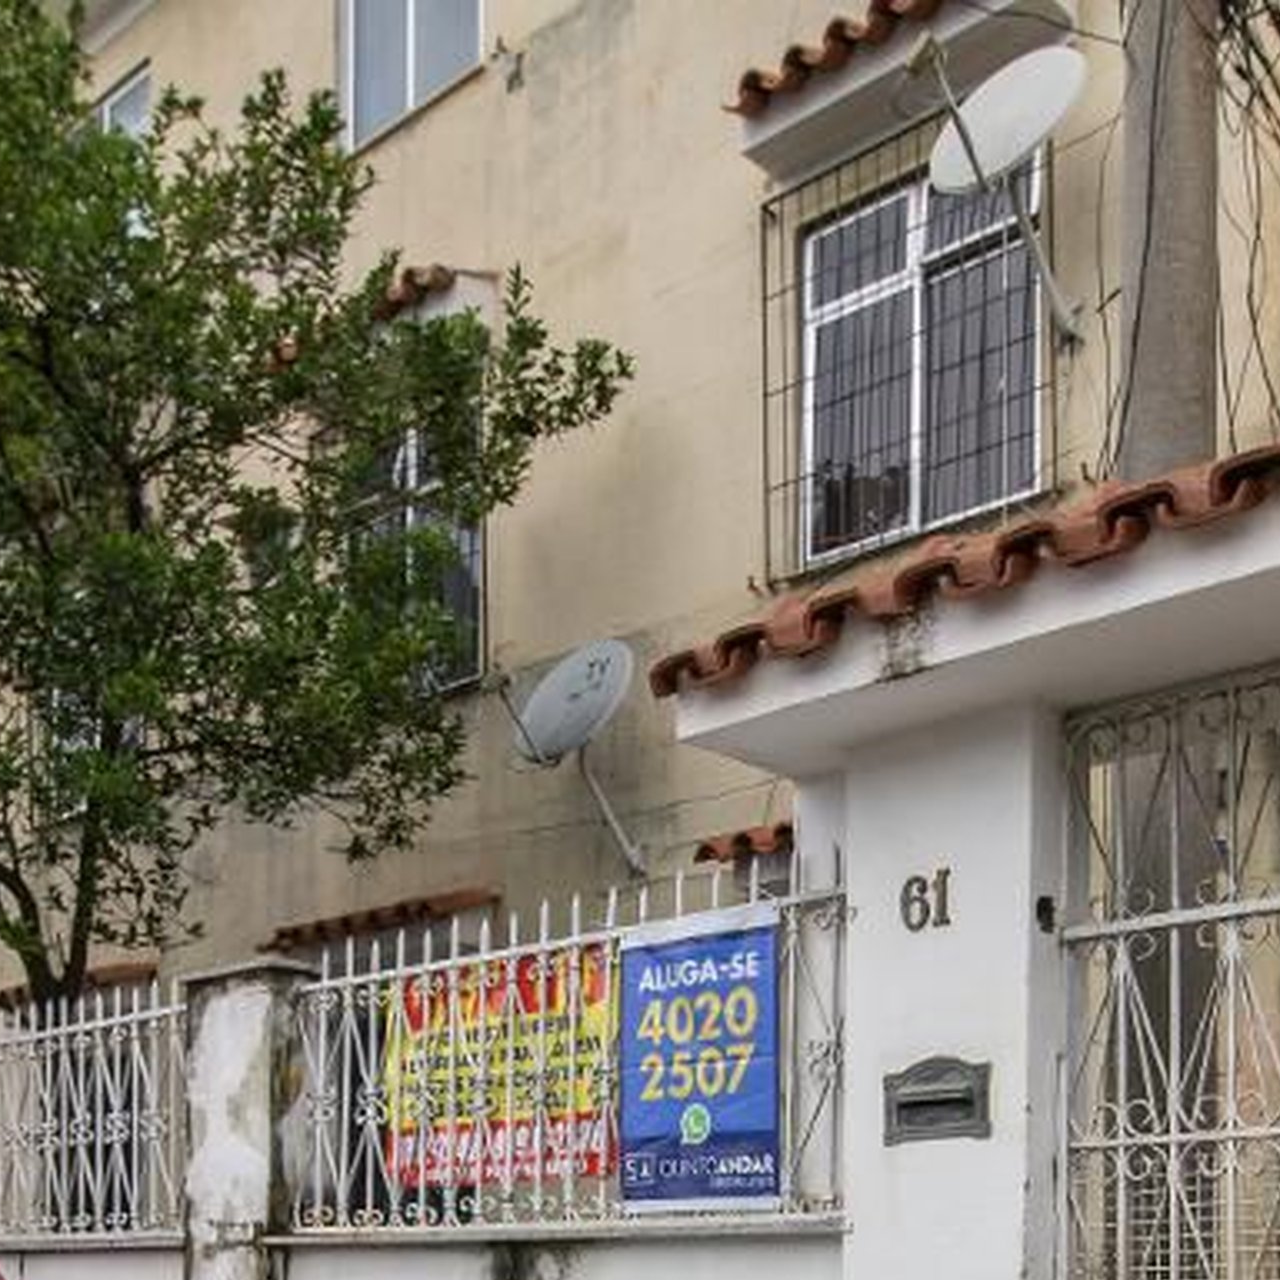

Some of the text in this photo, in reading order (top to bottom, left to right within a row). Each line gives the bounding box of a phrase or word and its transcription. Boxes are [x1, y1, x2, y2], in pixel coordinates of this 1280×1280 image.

[900, 868, 951, 932] 61
[639, 952, 759, 992] ALUGA-SE
[636, 986, 758, 1045] 4020
[639, 1043, 755, 1101] 2507
